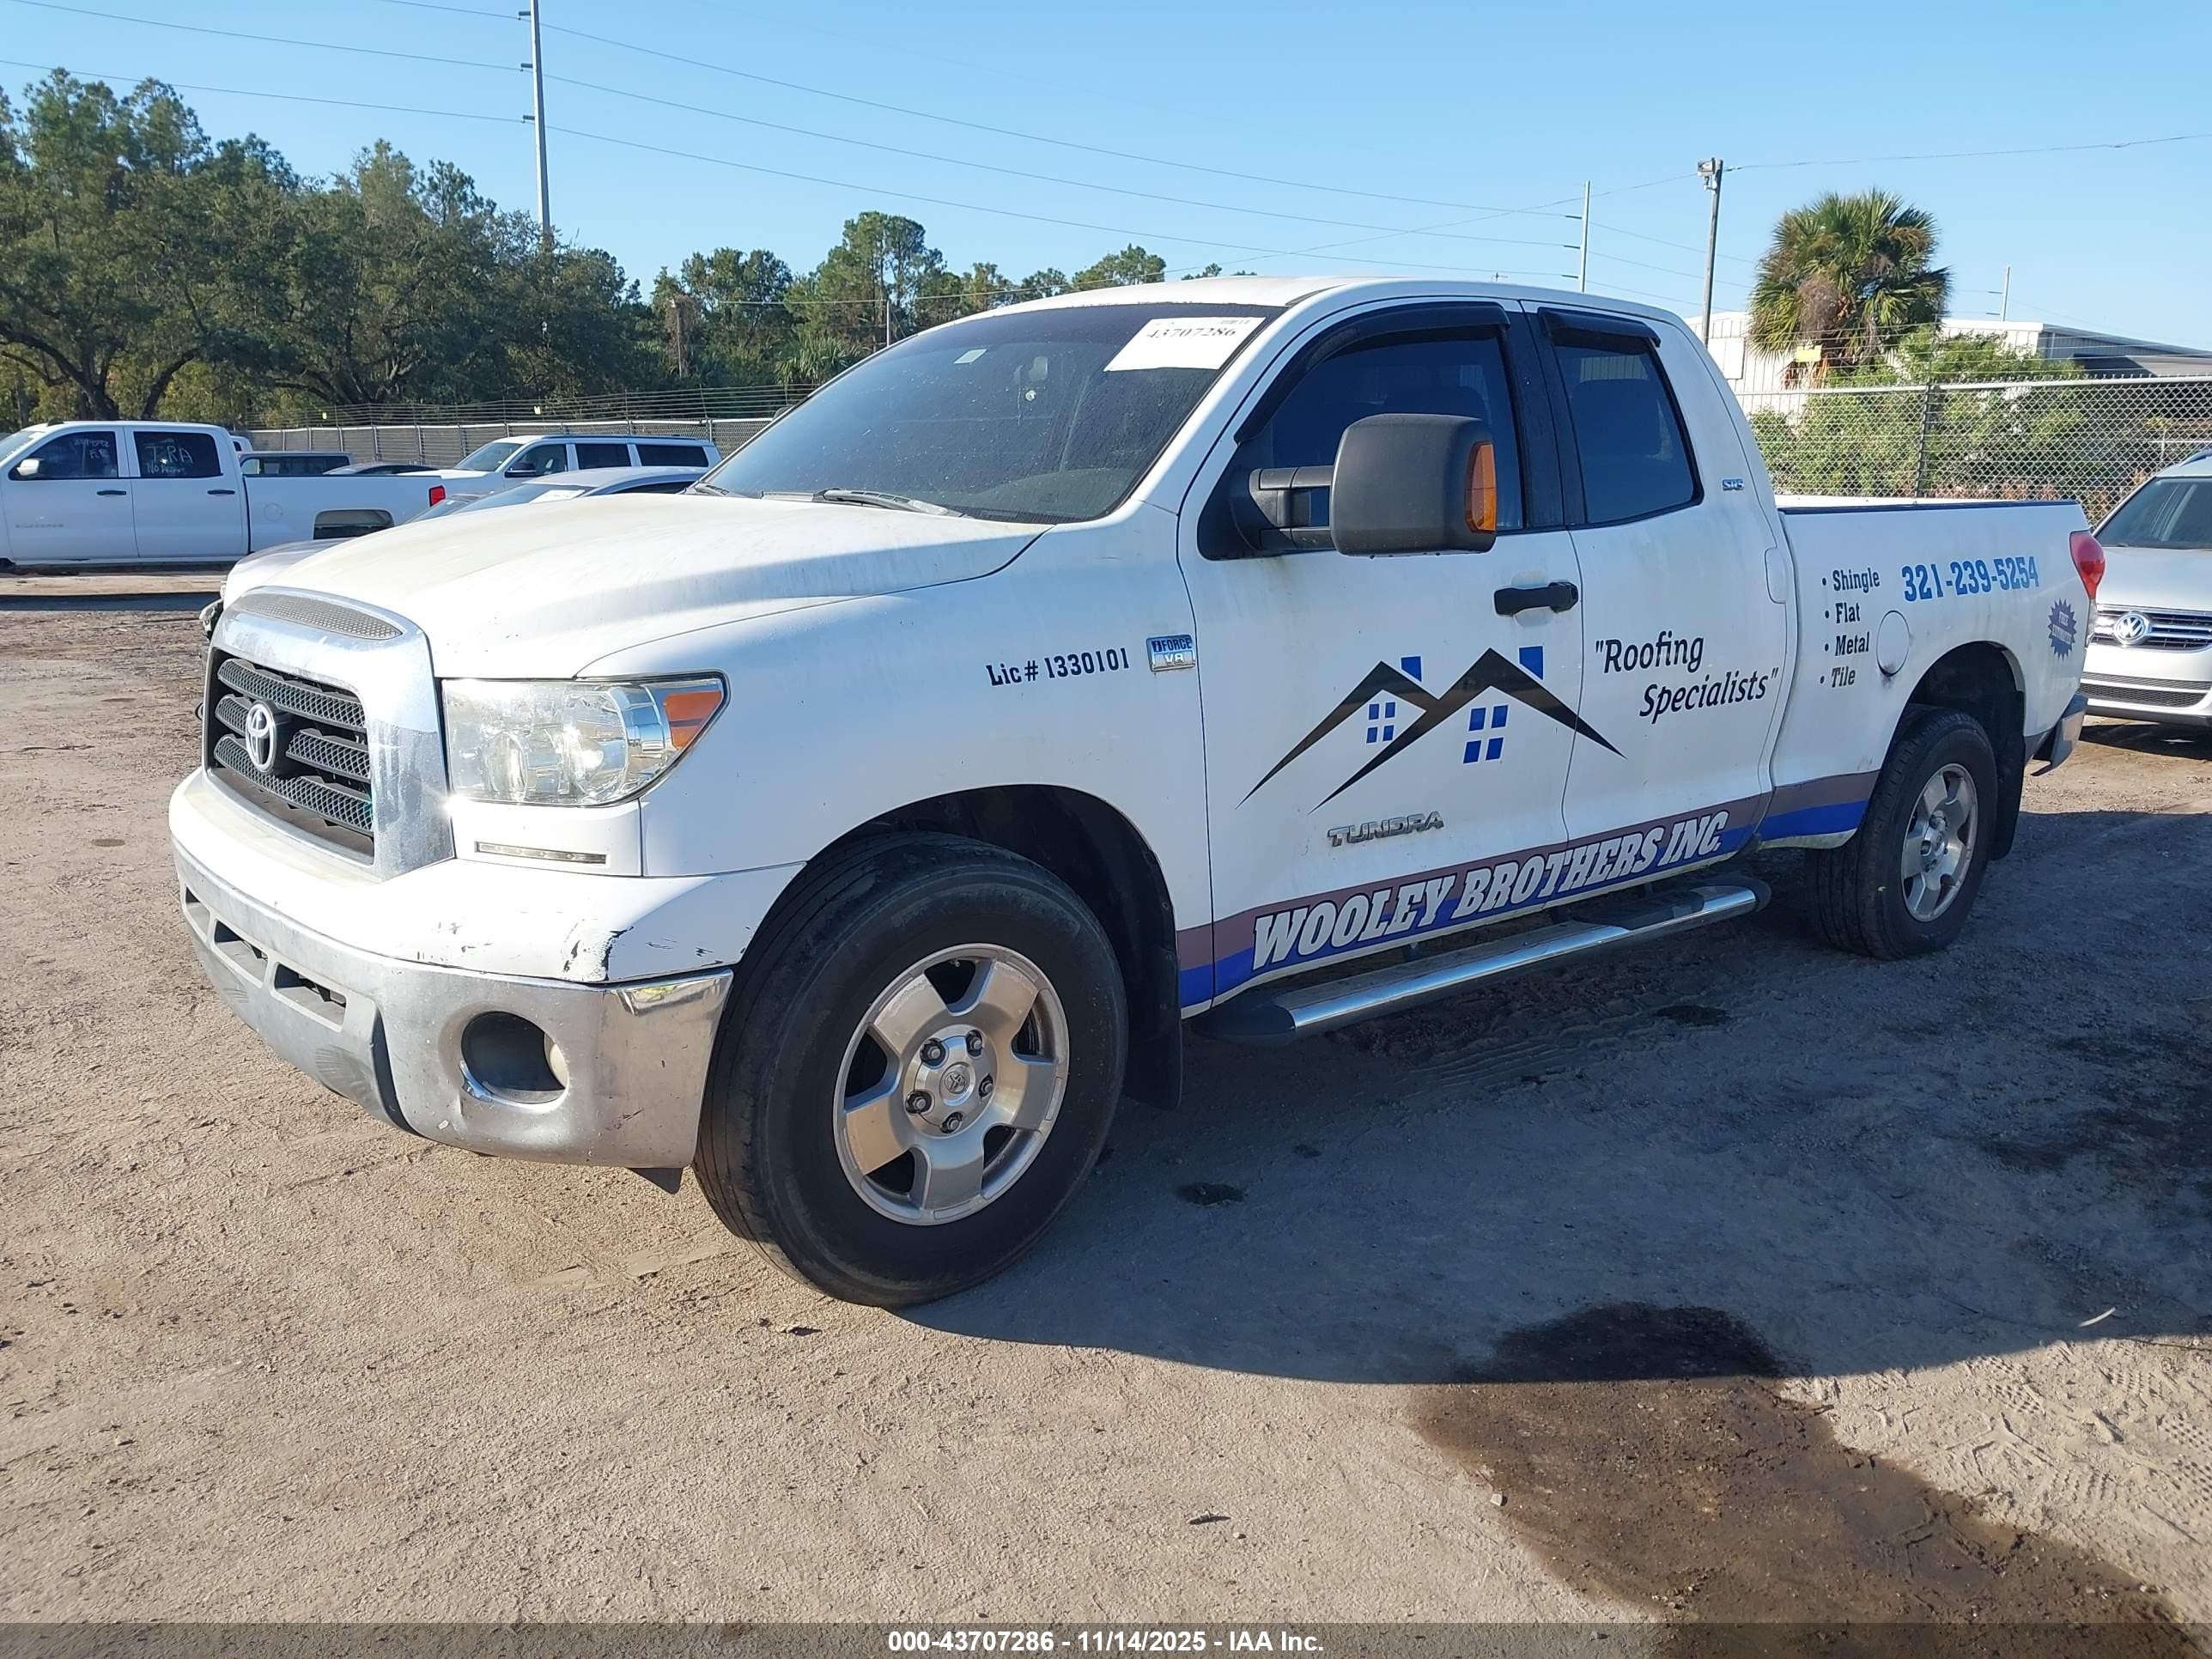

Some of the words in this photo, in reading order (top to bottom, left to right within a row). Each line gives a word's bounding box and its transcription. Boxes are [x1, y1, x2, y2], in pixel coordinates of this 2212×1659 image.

[1832, 567, 1881, 593] Shingle
[1901, 556, 2040, 602] 321-239-5254
[1836, 603, 1861, 624] Flat
[1595, 630, 1705, 673] "Roofing
[1834, 632, 1870, 657] Metal
[1044, 647, 1130, 678] 1330101
[1831, 666, 1856, 689] Tile
[1638, 667, 1779, 725] Specialists"
[1328, 811, 1444, 847] TUNDRA
[1251, 874, 1458, 971] WOOLEY
[1451, 826, 1666, 921] BROTHERS
